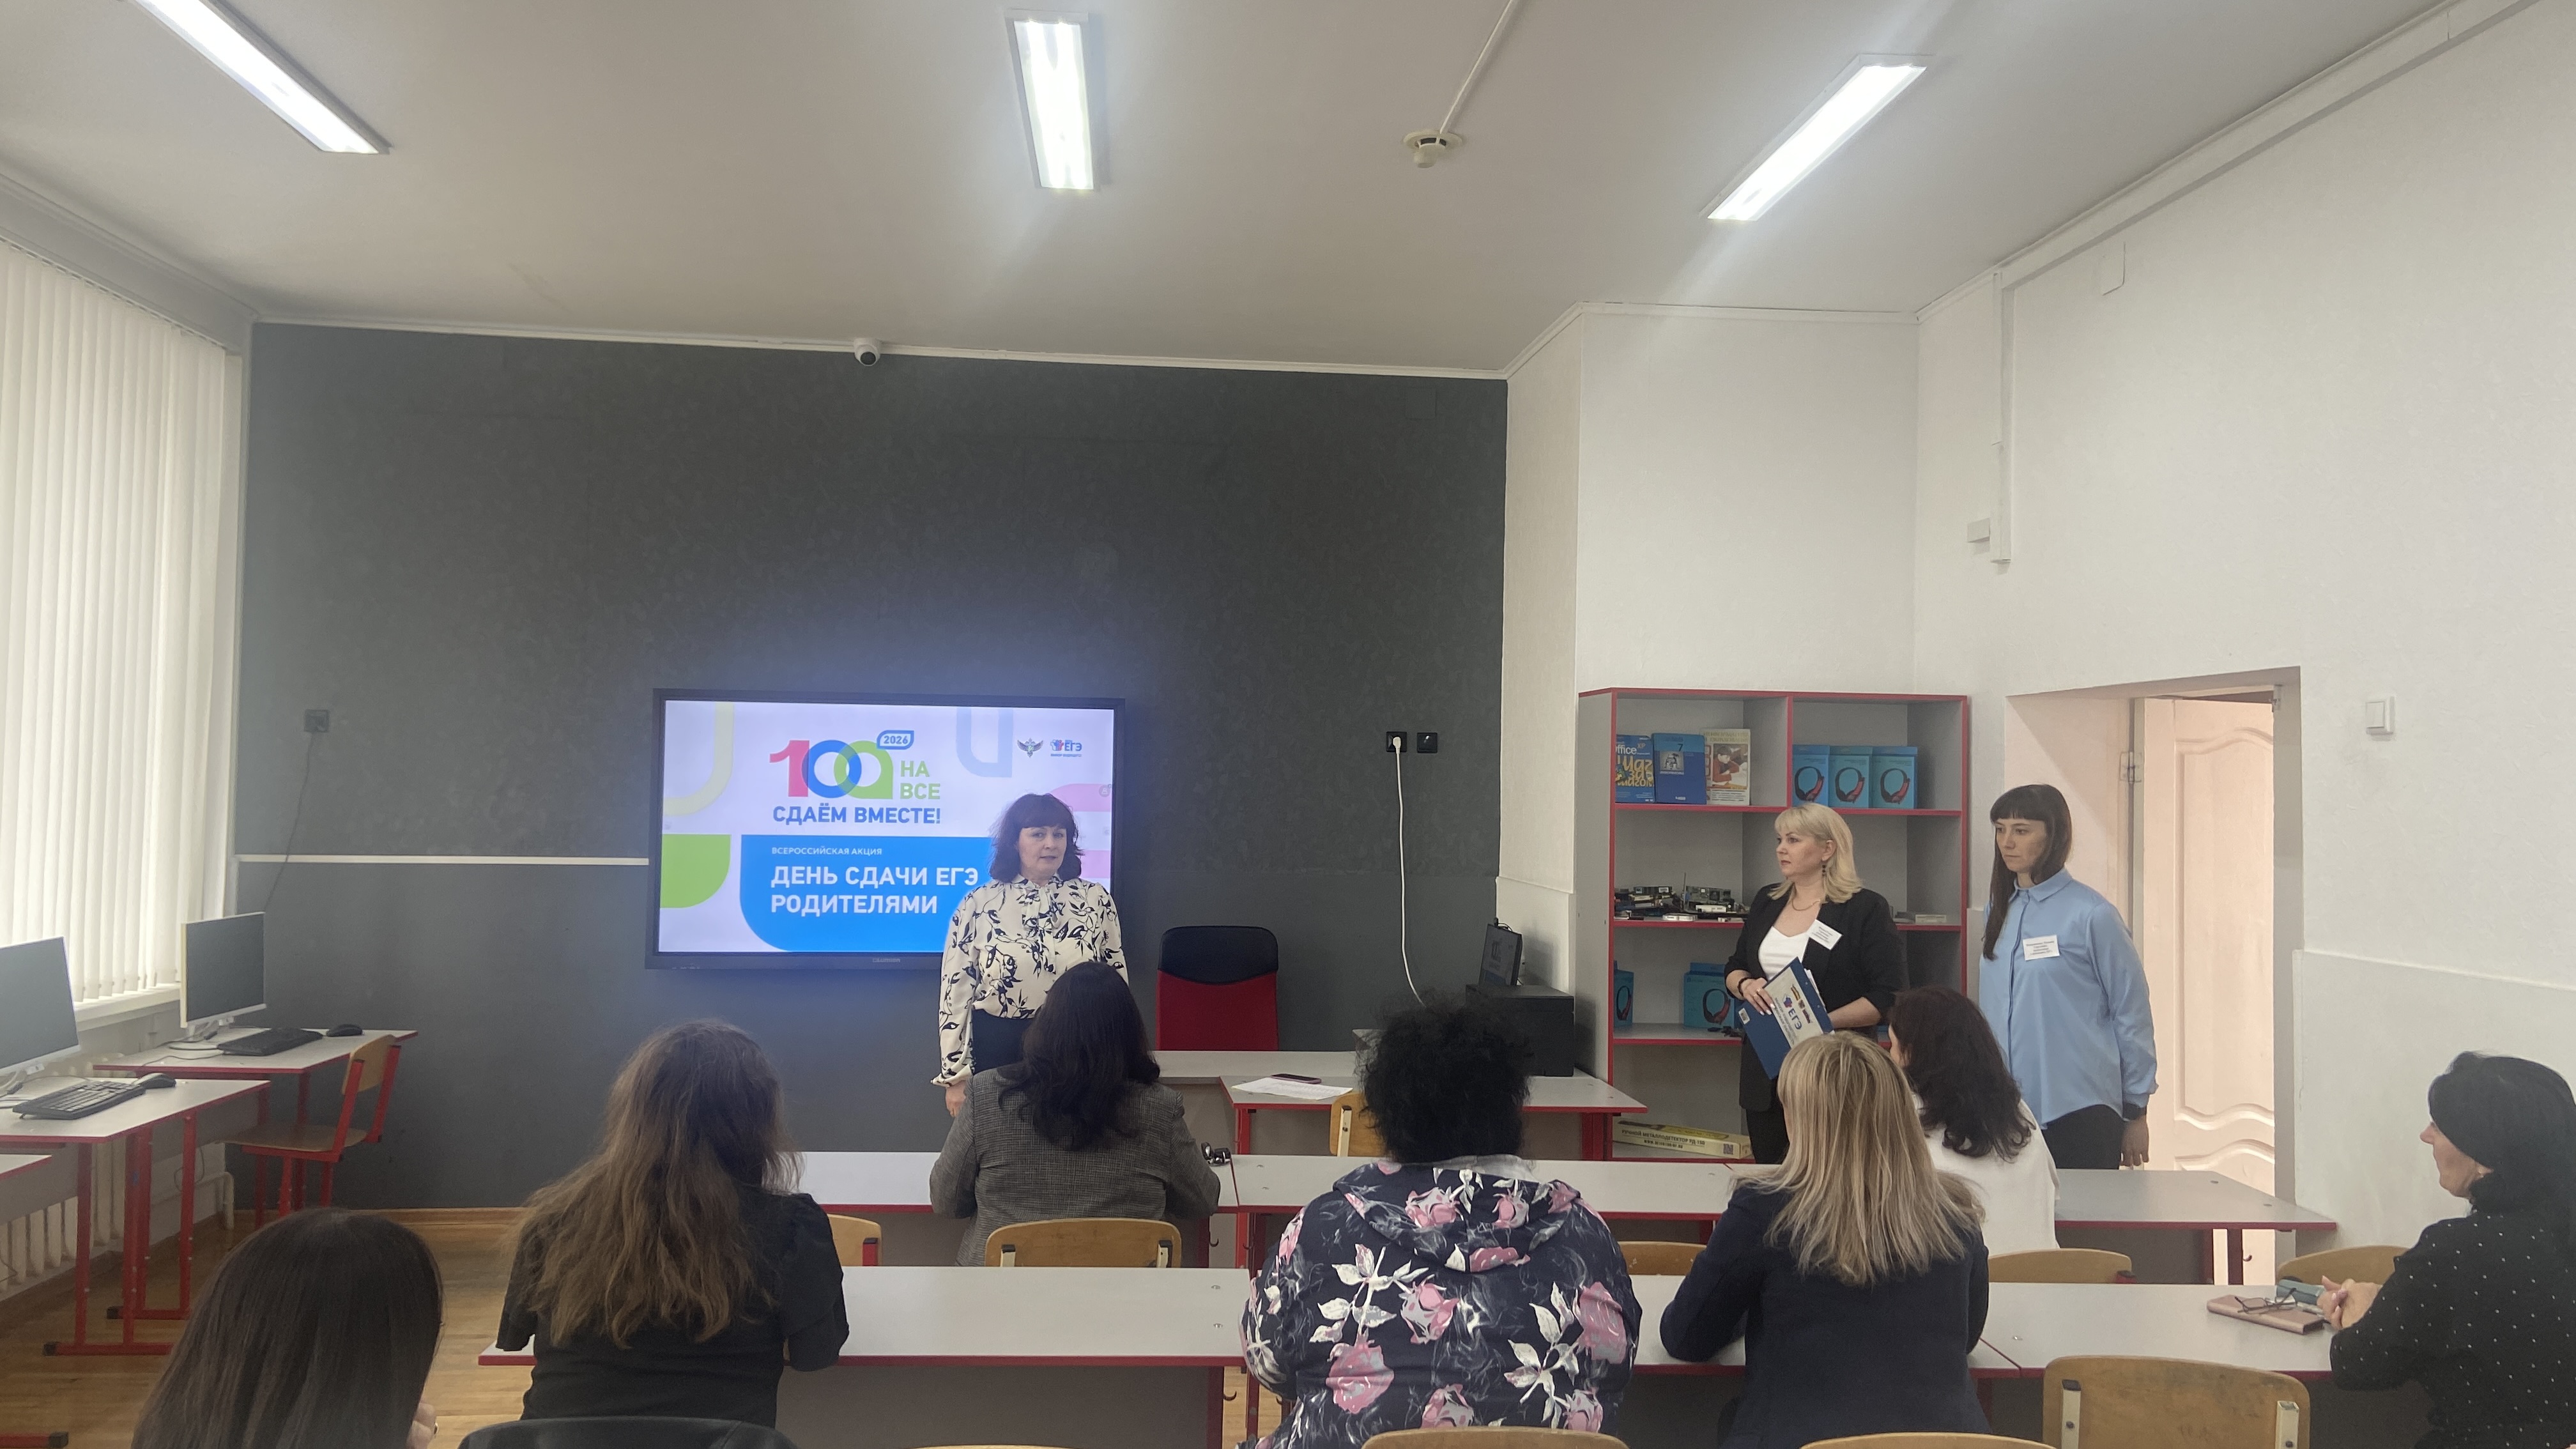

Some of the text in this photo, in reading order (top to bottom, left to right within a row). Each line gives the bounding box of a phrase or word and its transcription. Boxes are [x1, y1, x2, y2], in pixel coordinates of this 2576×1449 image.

[883, 735, 908, 744] 2026
[1678, 743, 1683, 752] 7
[1615, 744, 1637, 755] ffice
[900, 760, 930, 778] НА
[900, 783, 941, 799] ВСЕ
[772, 802, 941, 825] СДАЁМ ВМЕСТЕ!
[771, 846, 882, 857] ВСЕРОССИЙСКАЯ АКЦИЯ
[770, 866, 979, 889] ДЕНЬ СДАЧИ ЕГЭ
[770, 894, 938, 917] РОДИТЕЛЯМИ
[1788, 1008, 1802, 1030] ЕГЭ
[1621, 1129, 1642, 1137] РУЧНОЙ
